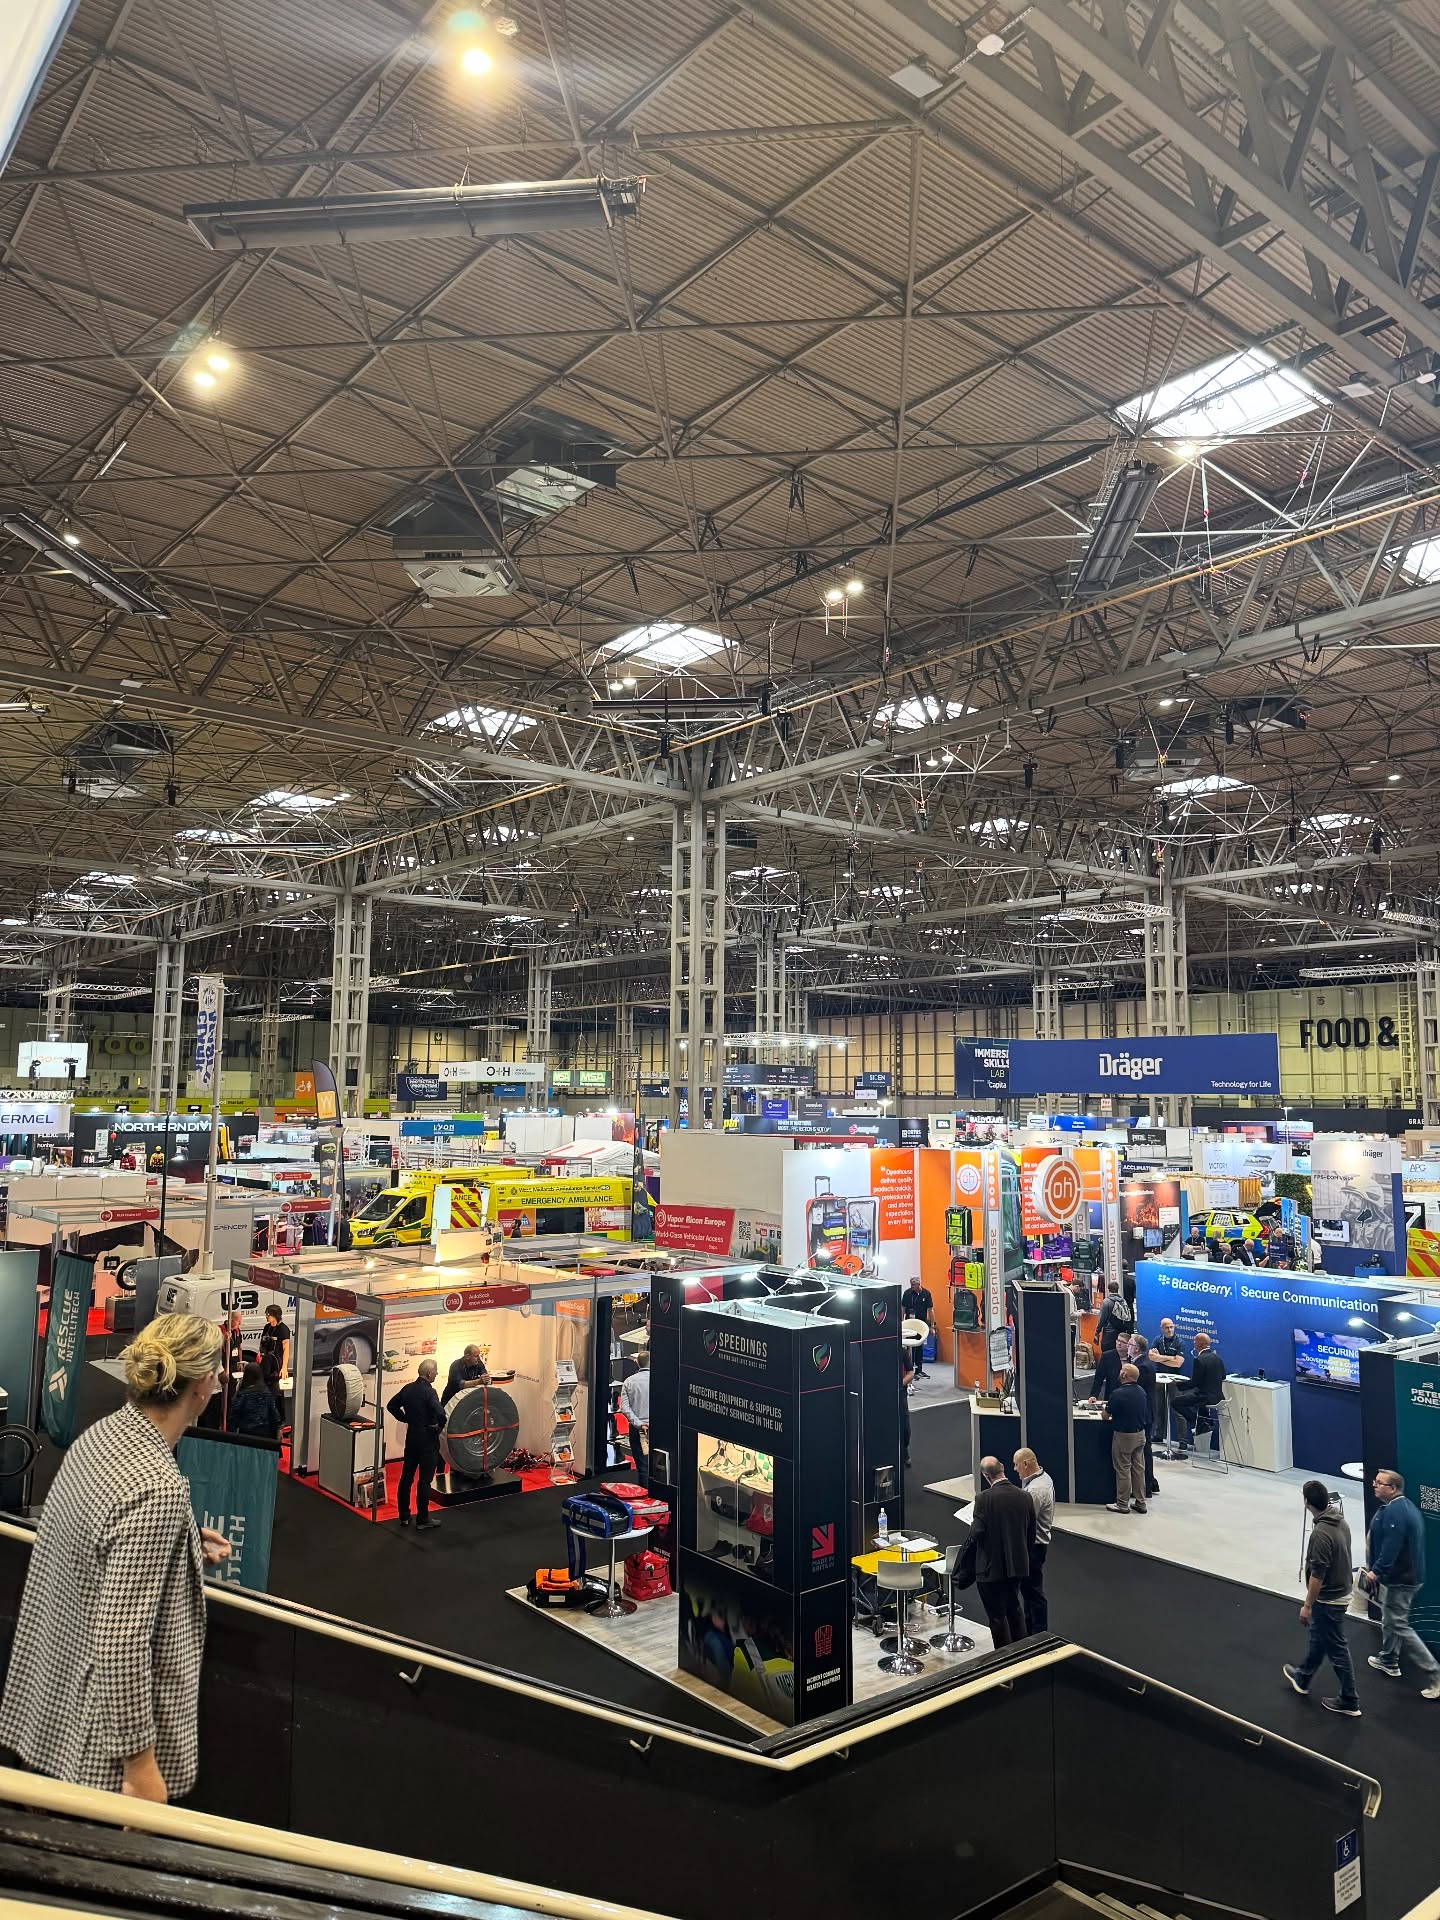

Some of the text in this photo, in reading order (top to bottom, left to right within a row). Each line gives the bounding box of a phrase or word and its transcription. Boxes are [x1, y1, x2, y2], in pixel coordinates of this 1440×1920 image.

[1300, 1016, 1399, 1049] FOOD &
[975, 1049, 1009, 1058] IMMERSI
[1099, 1053, 1163, 1080] Dräger
[989, 1081, 1007, 1089] Capita
[1249, 1080, 1258, 1088] for
[1259, 1080, 1272, 1088] Life
[114, 1122, 187, 1132] NORTHERN
[1409, 1163, 1426, 1172] APG
[521, 1195, 613, 1205] EMERGENCY AMBULANCE
[667, 1214, 726, 1227] Vapor Ricon Europe
[655, 1230, 724, 1243] World-Class Vehicular Access
[1241, 1286, 1280, 1301] Secure
[1283, 1290, 1379, 1313] Communication
[1180, 1307, 1209, 1317] Sovereign
[57, 1288, 73, 1361] RESCUE
[1175, 1315, 1205, 1324] Protection
[65, 1291, 80, 1363] INTELLITECH
[719, 1332, 768, 1358] SPEEDINGS
[689, 1383, 782, 1419] PROTECTIVE EQUIPMENT & SUPPLIES
[1411, 1395, 1440, 1406] JONE
[688, 1395, 783, 1433] FOR EMERGENCY SERVICES IN THE UK
[812, 1557, 827, 1567] MADE
